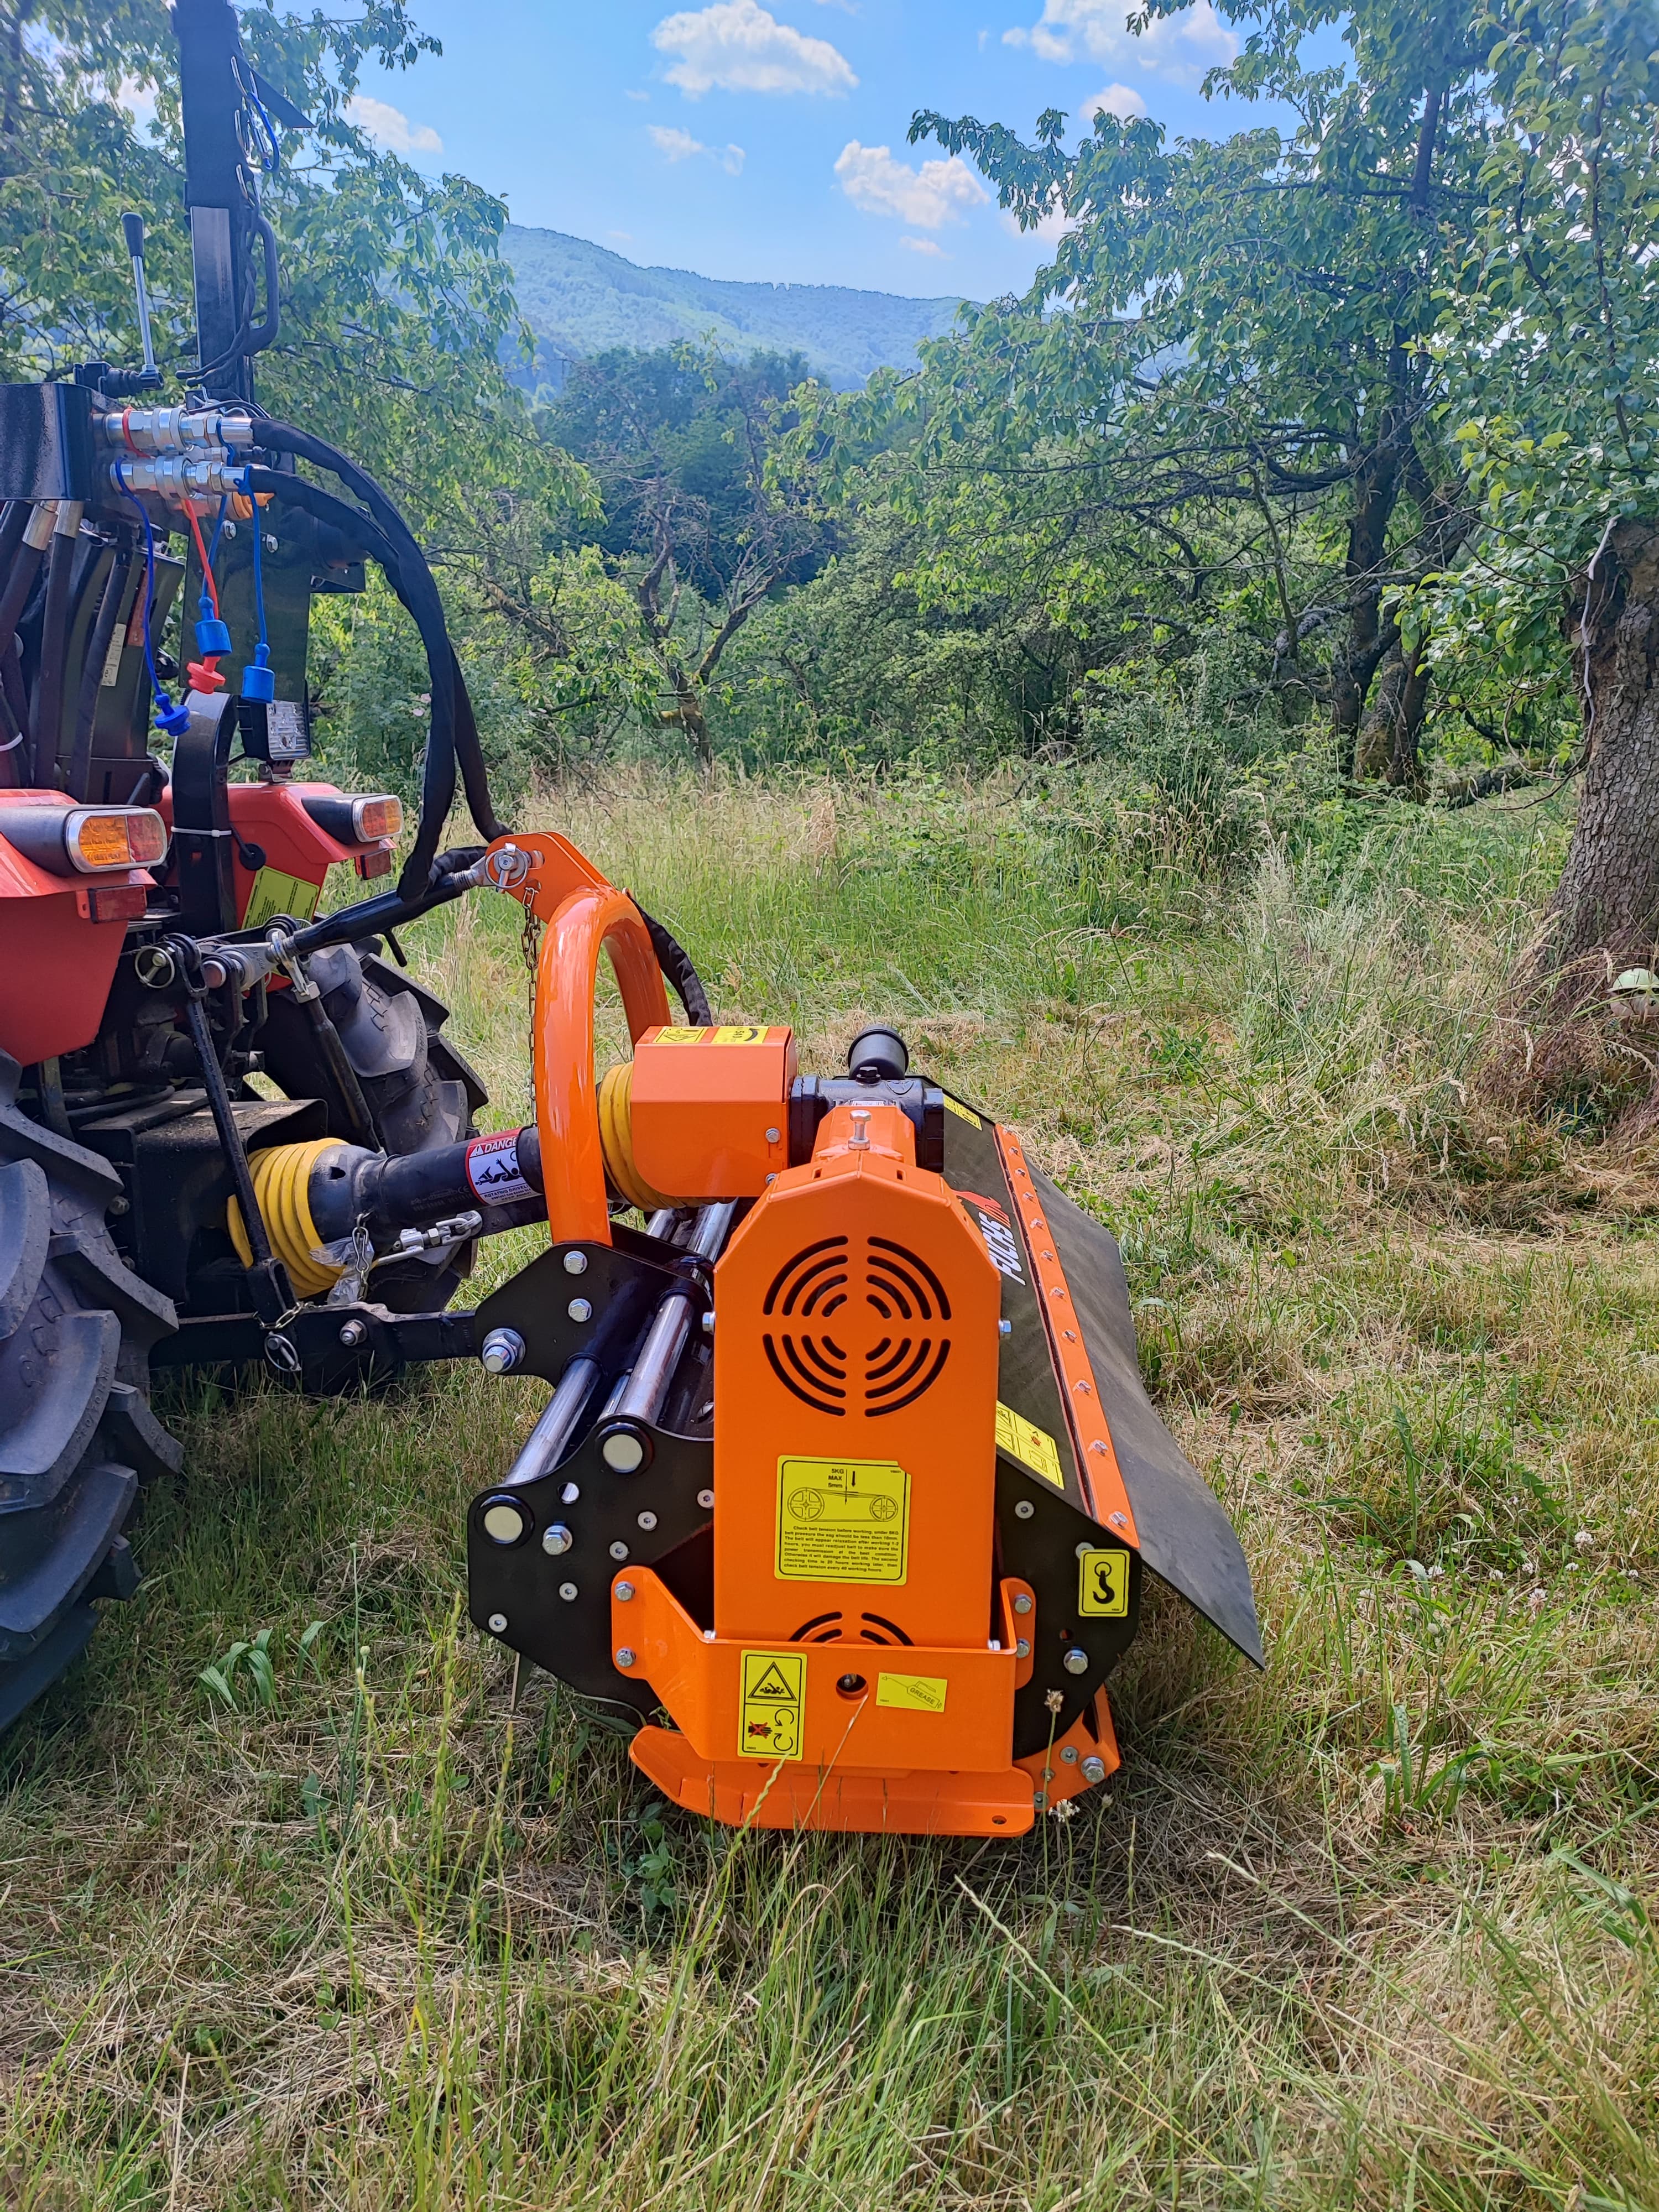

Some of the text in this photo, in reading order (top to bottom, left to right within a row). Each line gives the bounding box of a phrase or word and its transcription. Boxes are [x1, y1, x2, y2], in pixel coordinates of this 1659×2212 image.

[484, 1137, 517, 1154] DANGE
[484, 1190, 508, 1198] ROTATING
[978, 1212, 1026, 1286] FUCHS
[910, 1687, 935, 1704] GREASE
